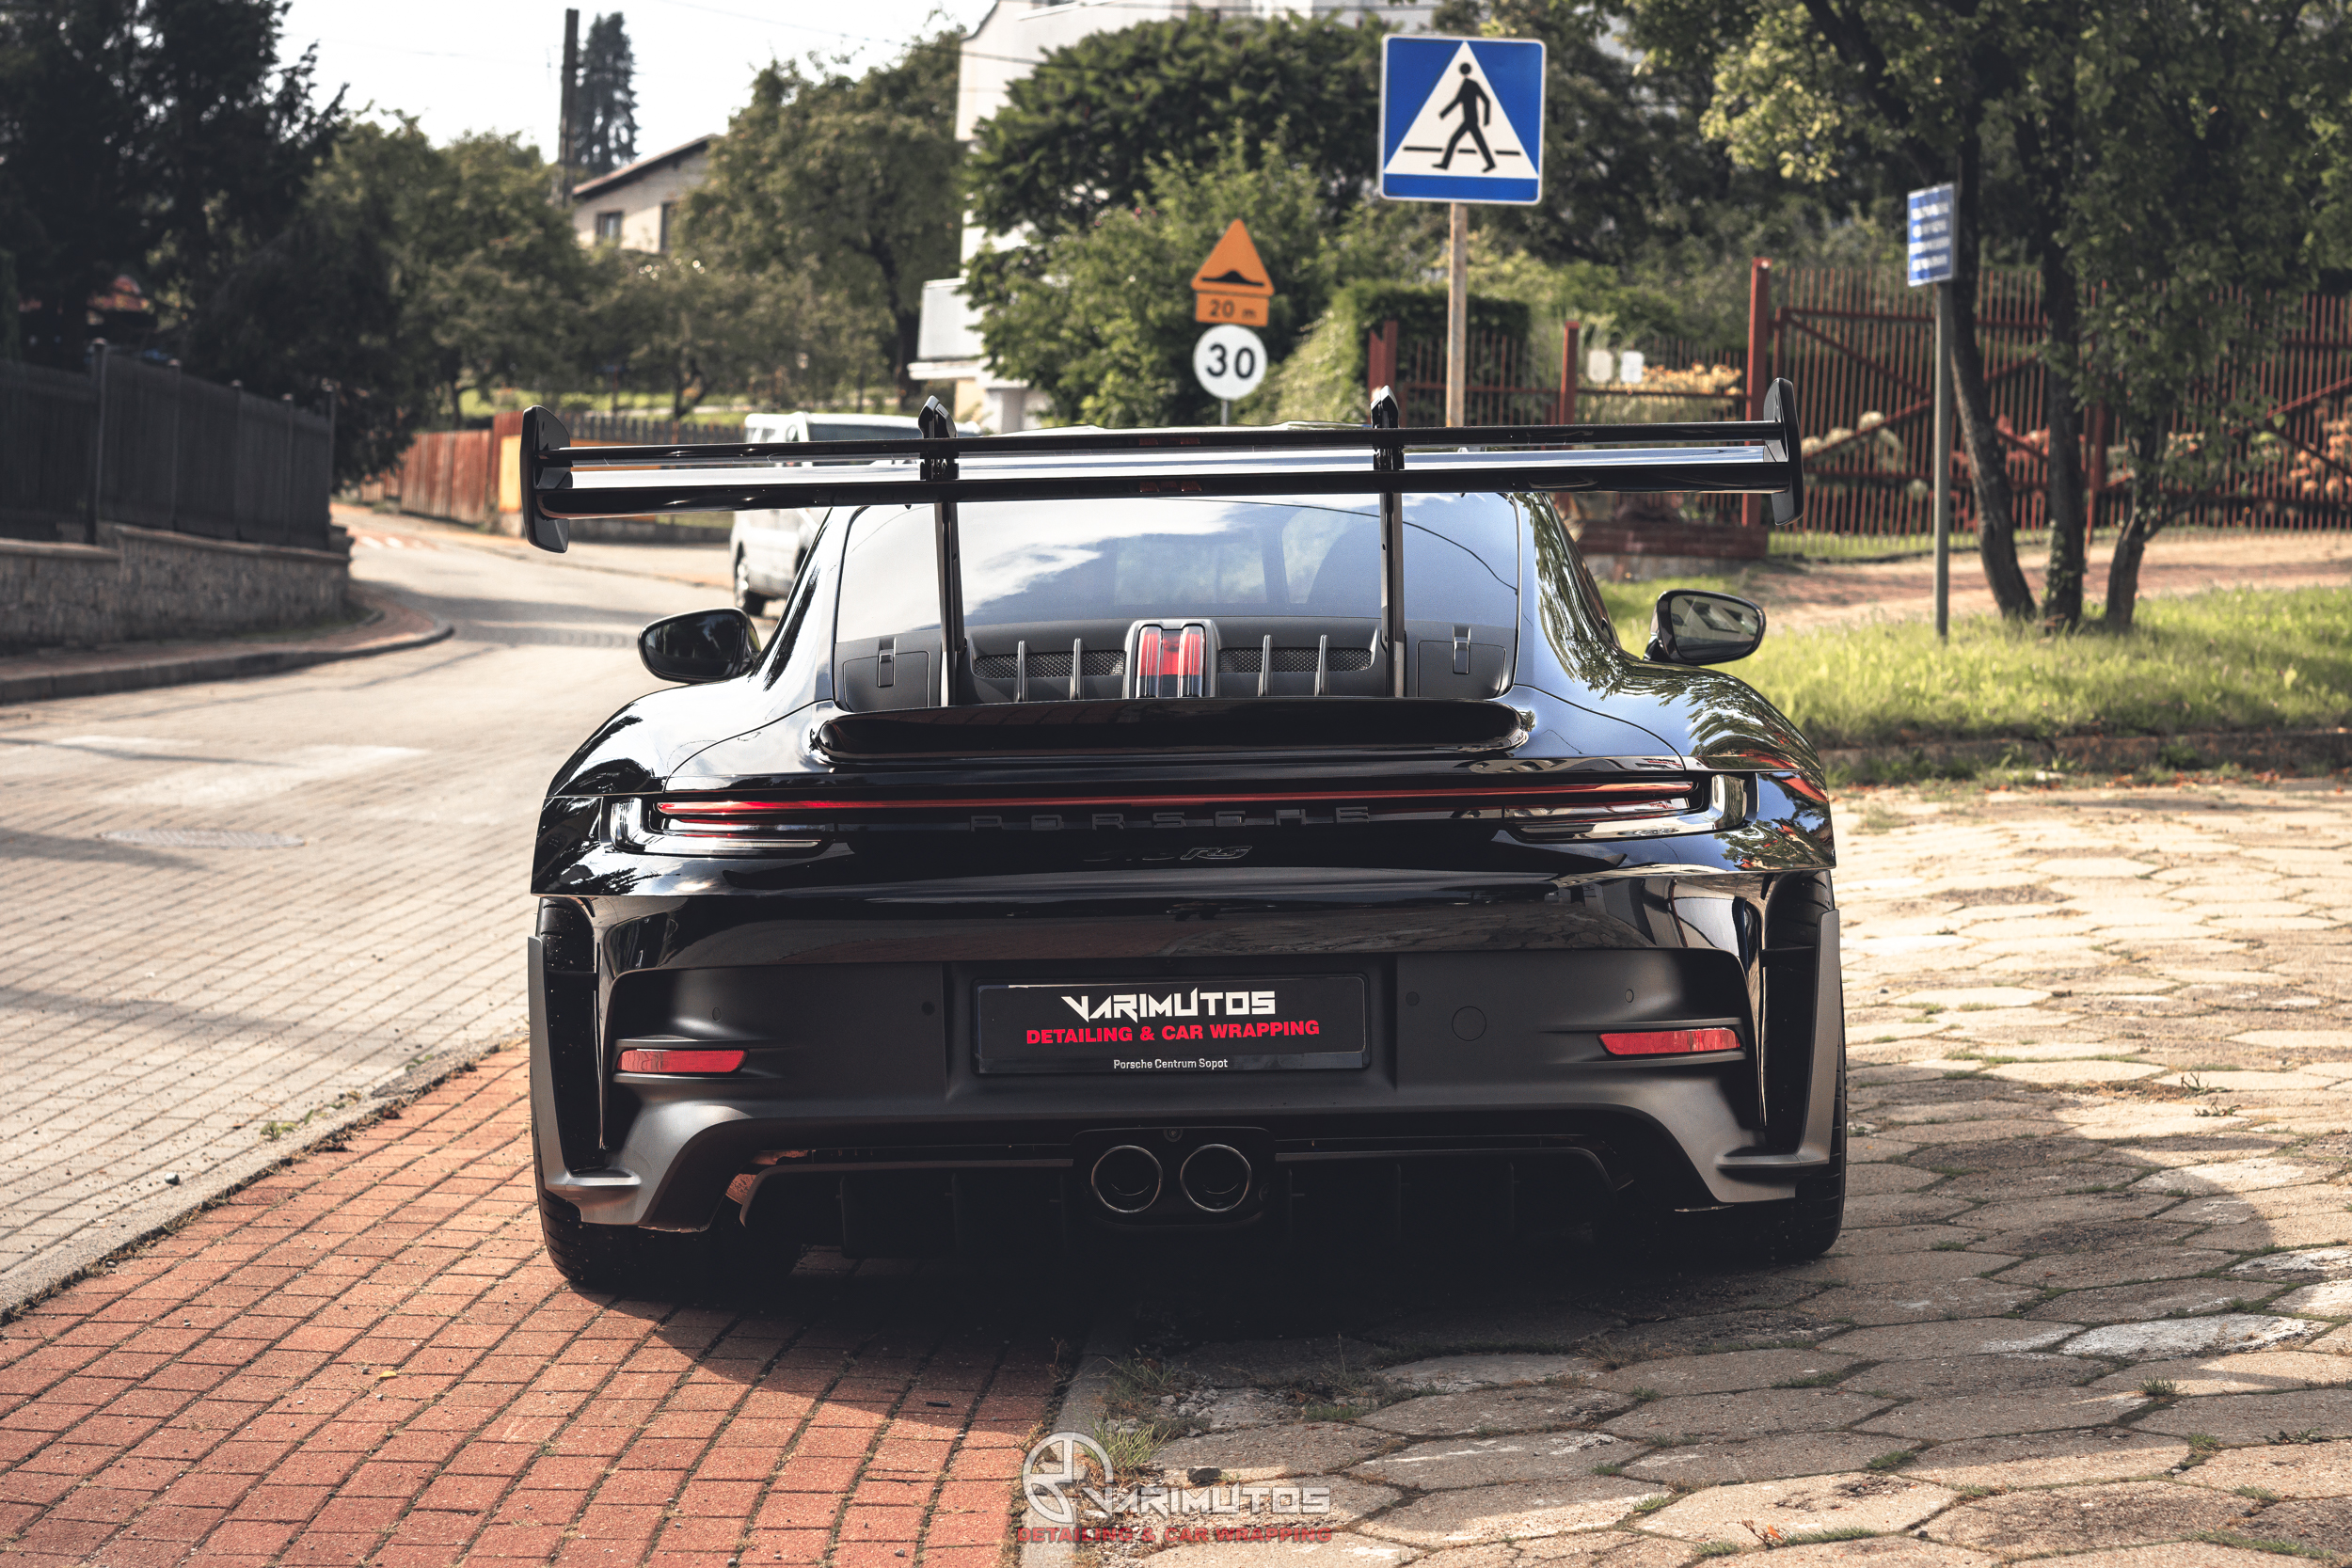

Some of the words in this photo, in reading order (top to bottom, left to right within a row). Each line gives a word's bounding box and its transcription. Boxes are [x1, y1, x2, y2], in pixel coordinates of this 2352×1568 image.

[1210, 299, 1234, 318] 20
[1206, 342, 1256, 379] 30
[970, 806, 1370, 832] PORSCHE
[1061, 988, 1276, 1023] VARIMUTOS
[1026, 1026, 1133, 1044] DETAILING
[1139, 1025, 1155, 1041] &
[1161, 1024, 1203, 1040] CAR
[1210, 1020, 1320, 1038] WRAPPING
[1113, 1059, 1153, 1069] Porsche
[1154, 1058, 1197, 1069] Centrum
[1199, 1058, 1228, 1069] Sopot
